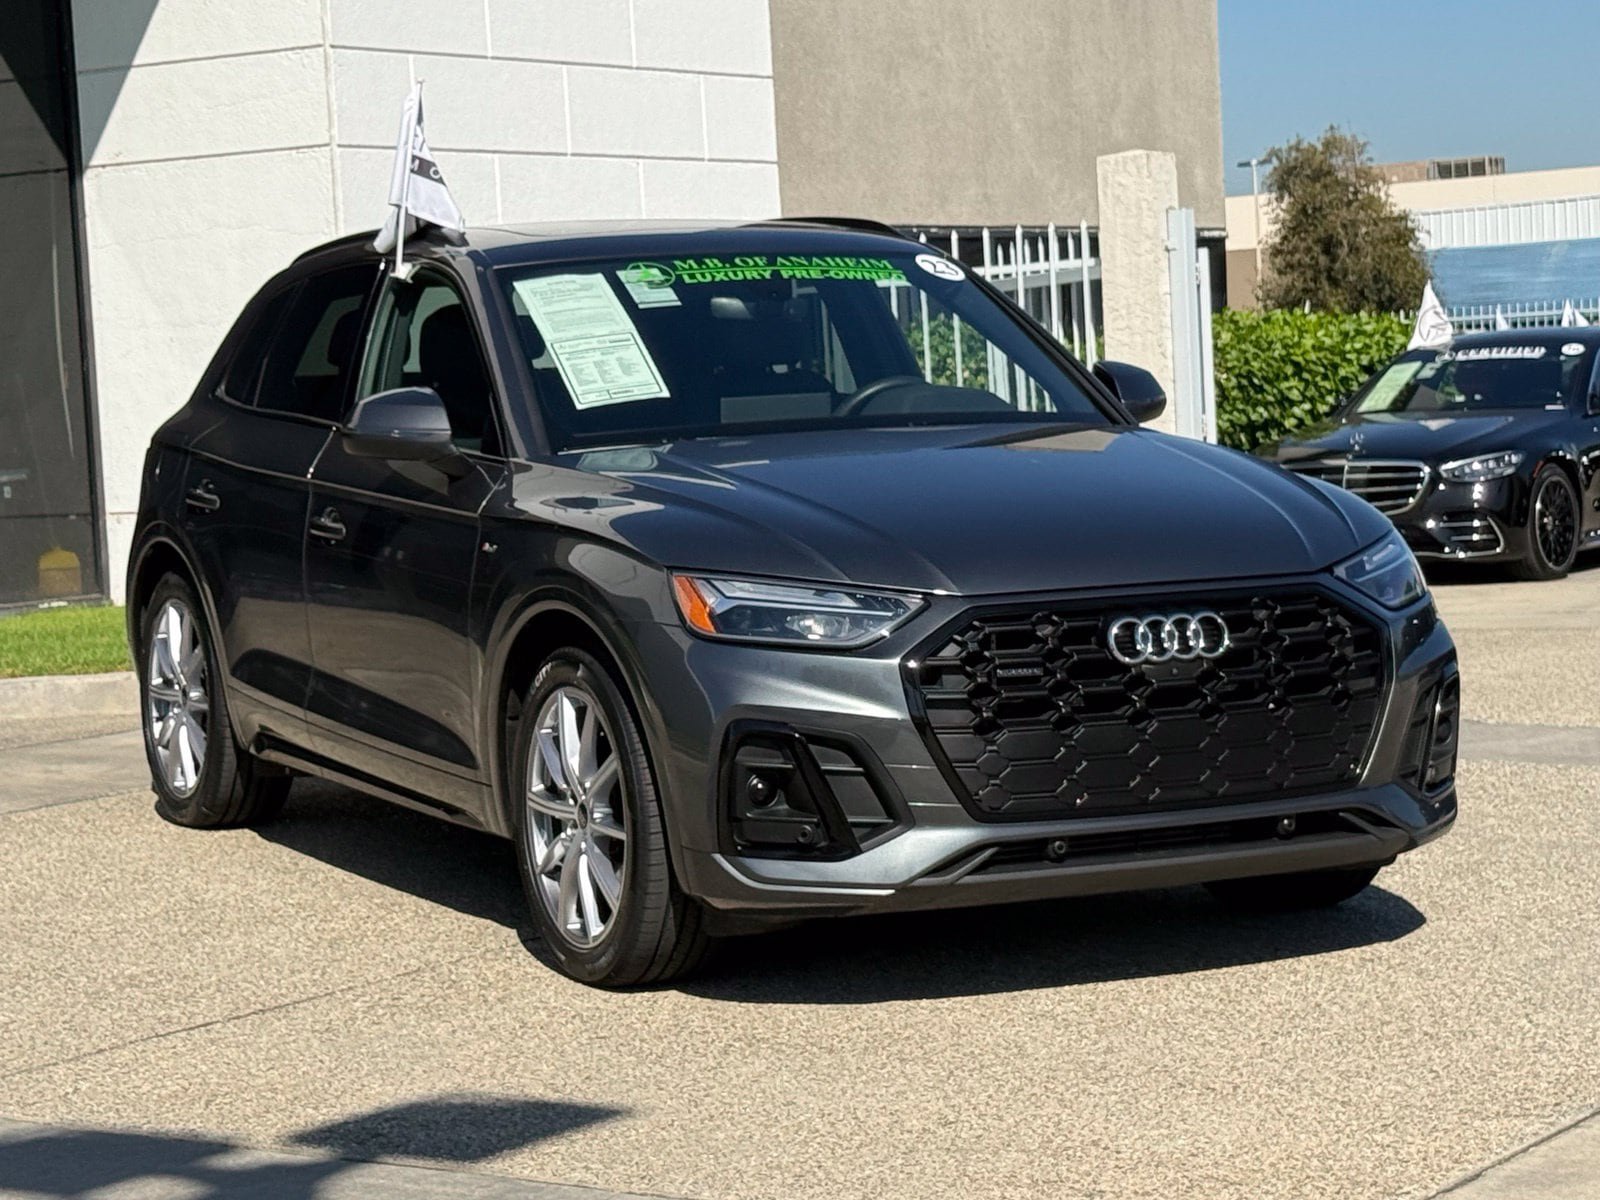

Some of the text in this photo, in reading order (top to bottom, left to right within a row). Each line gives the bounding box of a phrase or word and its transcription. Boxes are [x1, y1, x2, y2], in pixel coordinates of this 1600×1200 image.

[673, 256, 893, 271] M.B. OF ANAHEIM
[682, 268, 907, 284] LUXURY PRE-OWNED
